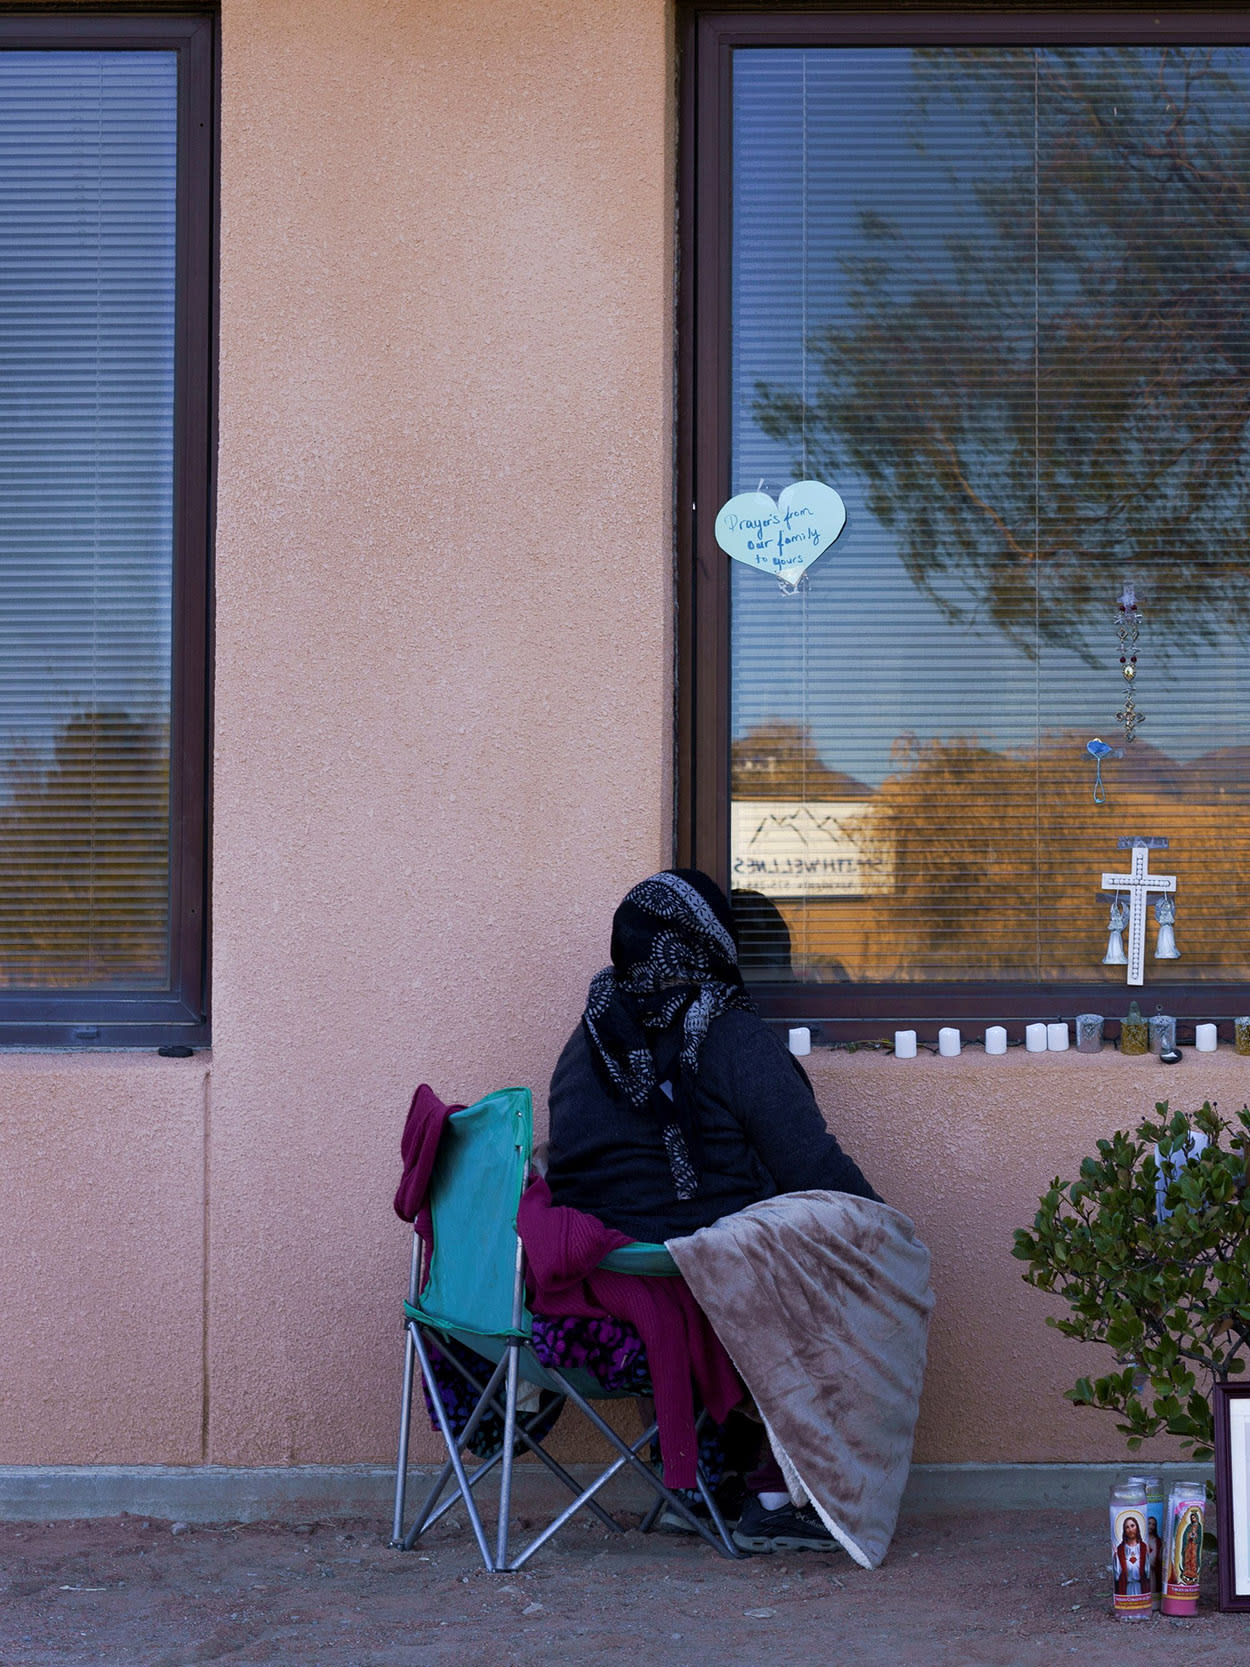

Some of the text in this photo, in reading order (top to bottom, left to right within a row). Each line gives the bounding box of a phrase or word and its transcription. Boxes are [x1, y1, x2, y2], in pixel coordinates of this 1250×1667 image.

[783, 505, 814, 530] from
[776, 527, 821, 556] family
[756, 554, 803, 571] to yours
